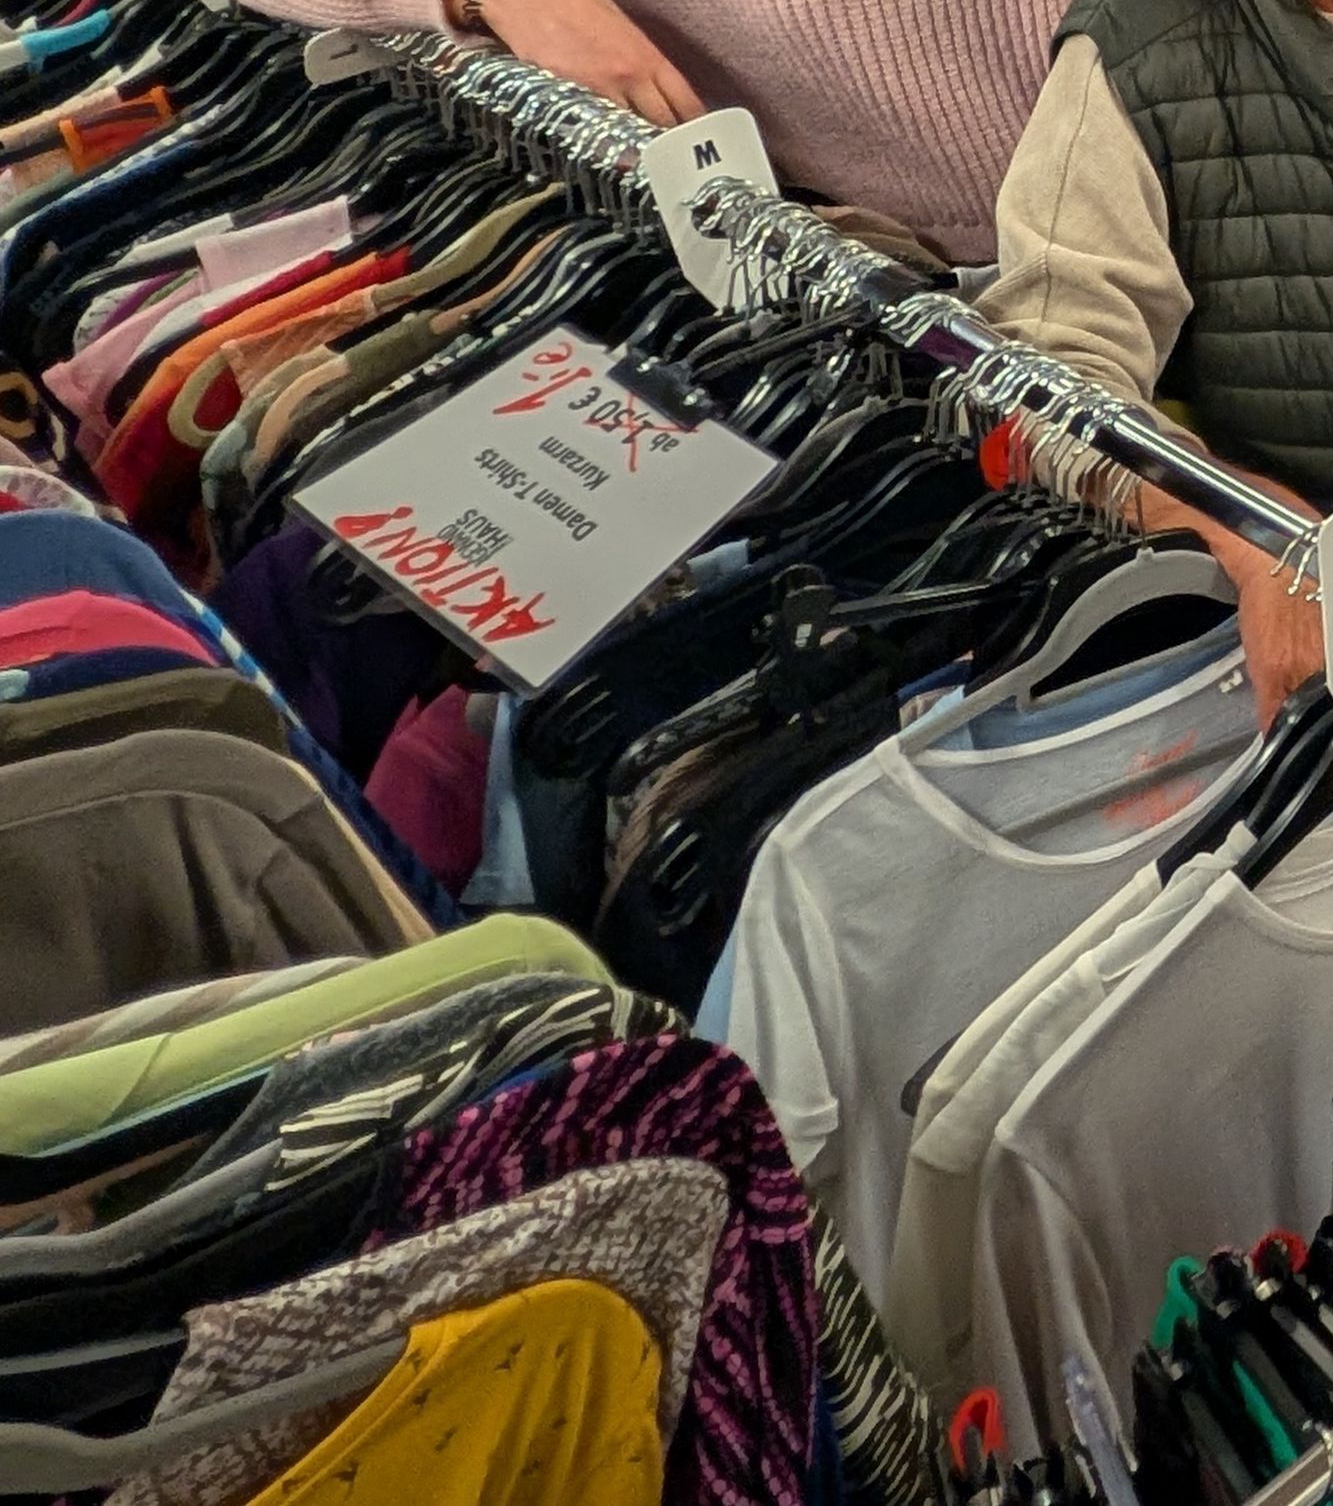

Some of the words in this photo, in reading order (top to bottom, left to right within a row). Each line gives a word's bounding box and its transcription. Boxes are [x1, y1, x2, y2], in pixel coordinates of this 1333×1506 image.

[692, 139, 722, 171] M
[567, 385, 602, 411] €
[537, 435, 611, 492] Kurzarm
[649, 431, 680, 453] ab
[474, 447, 539, 501] T-Shirts
[456, 508, 508, 553] HAUS
[532, 487, 598, 542] Damen
[334, 506, 556, 643] AKTION!
